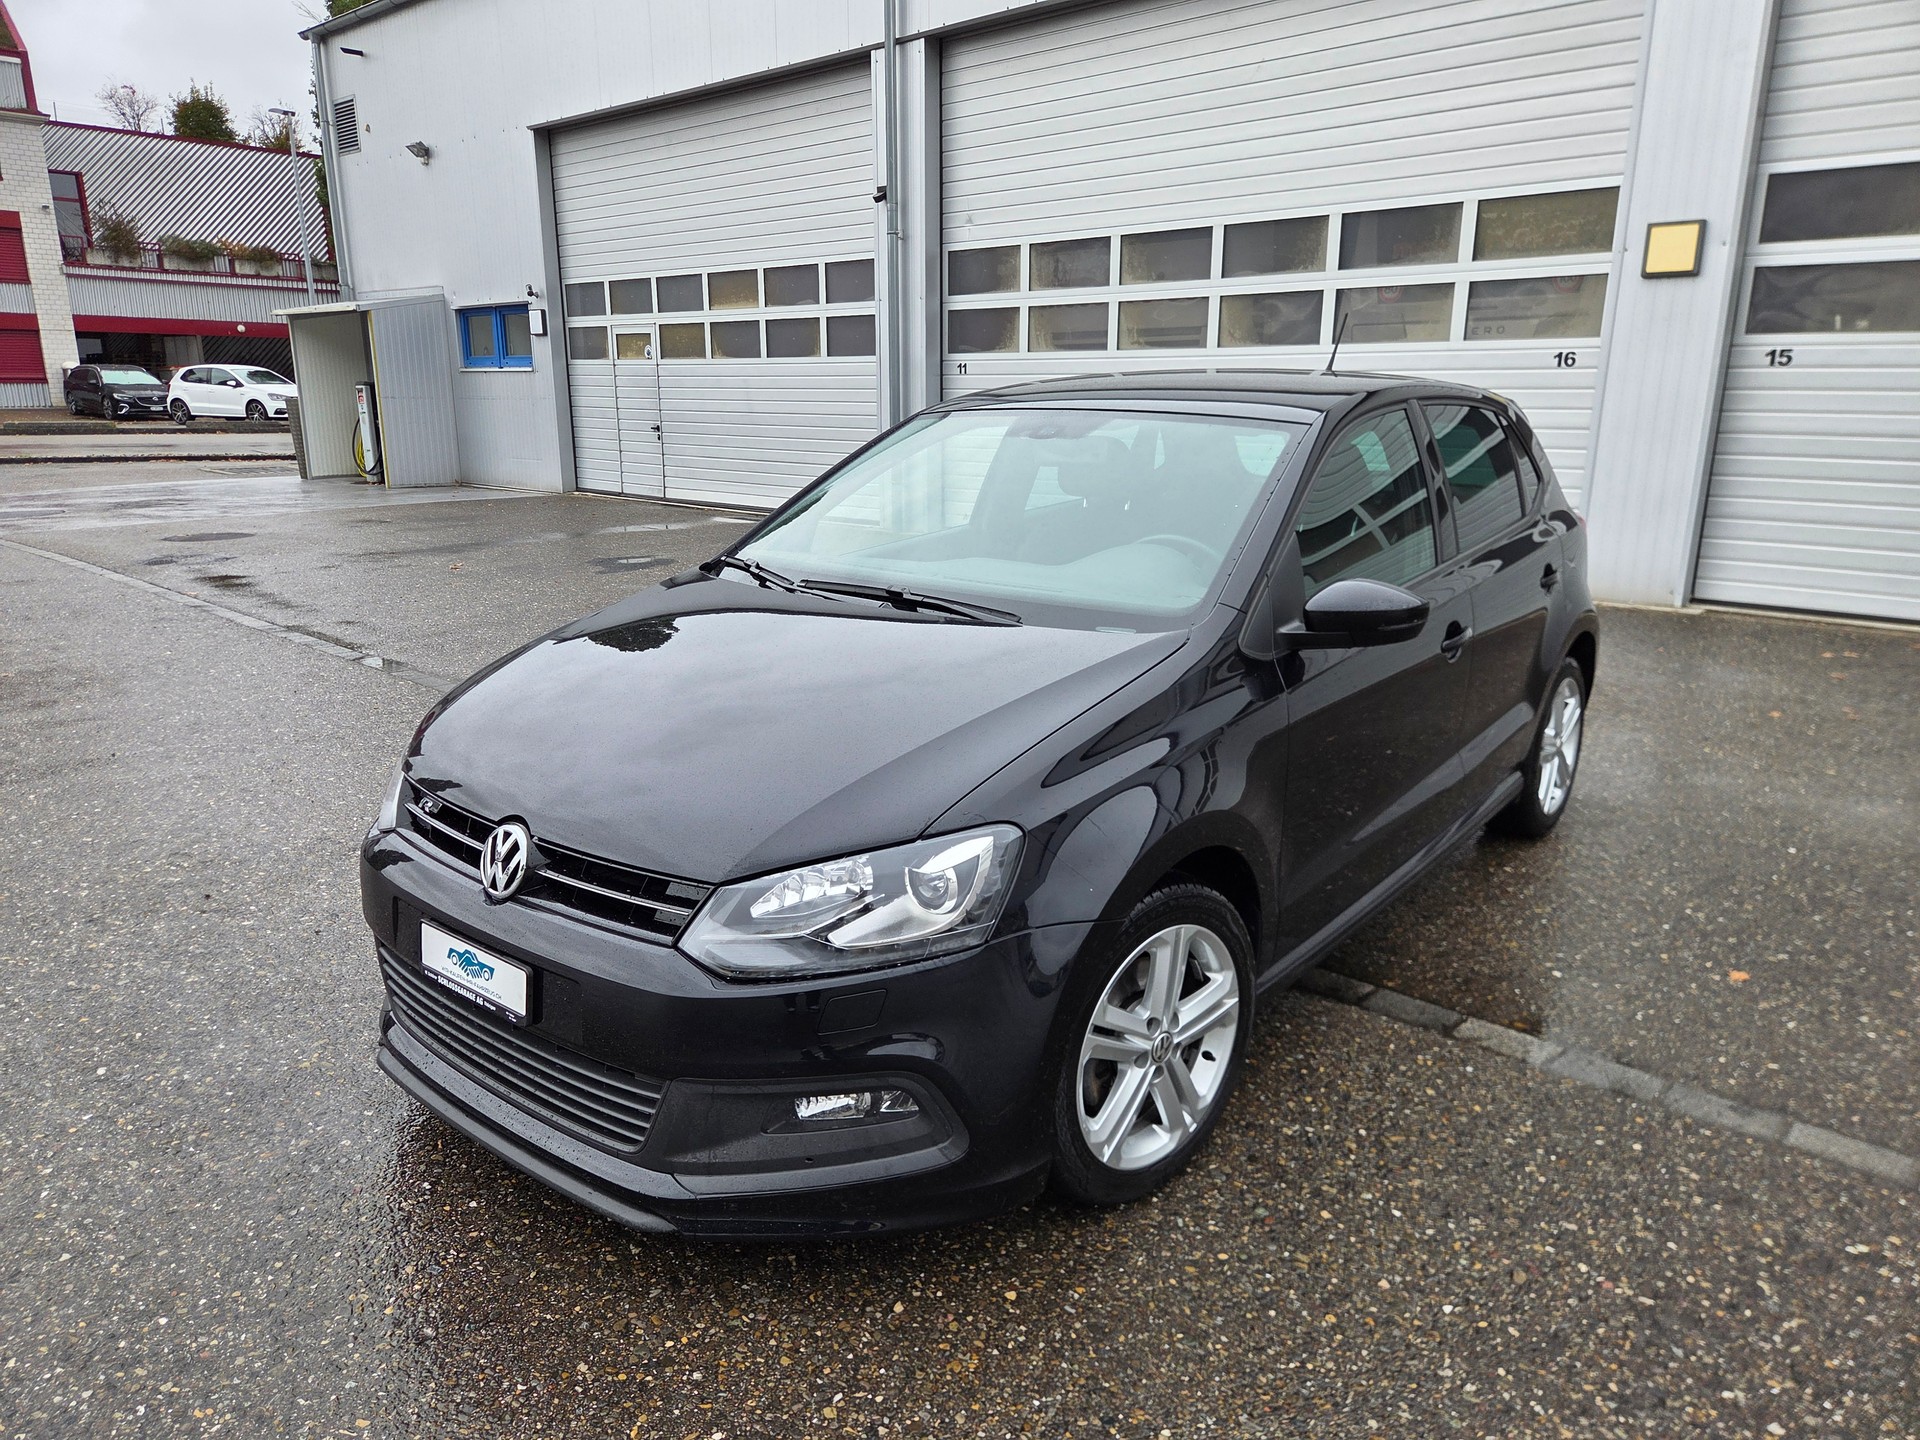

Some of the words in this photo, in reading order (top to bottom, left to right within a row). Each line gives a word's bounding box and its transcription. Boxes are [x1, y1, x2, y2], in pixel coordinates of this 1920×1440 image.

[1553, 351, 1577, 368] 16
[1764, 348, 1794, 367] 15
[956, 362, 967, 375] 11
[481, 824, 527, 898] VW
